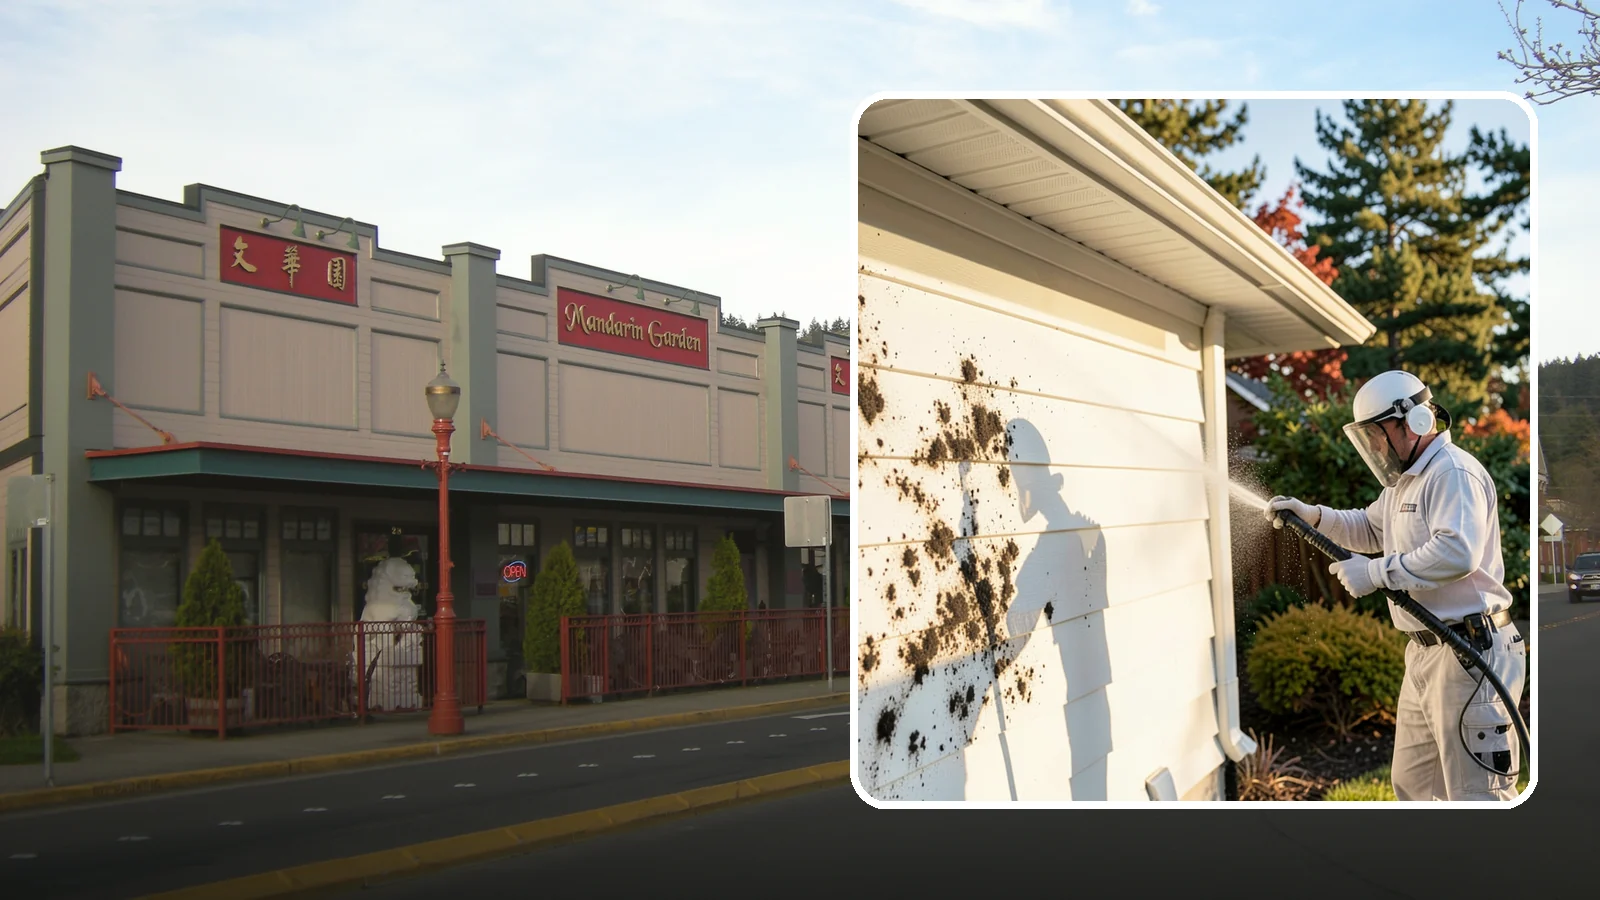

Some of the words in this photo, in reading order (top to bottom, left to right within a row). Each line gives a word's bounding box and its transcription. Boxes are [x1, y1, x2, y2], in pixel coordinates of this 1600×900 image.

[565, 302, 644, 341] Mandarin
[648, 320, 701, 352] Garden
[503, 565, 527, 578] OPEN
